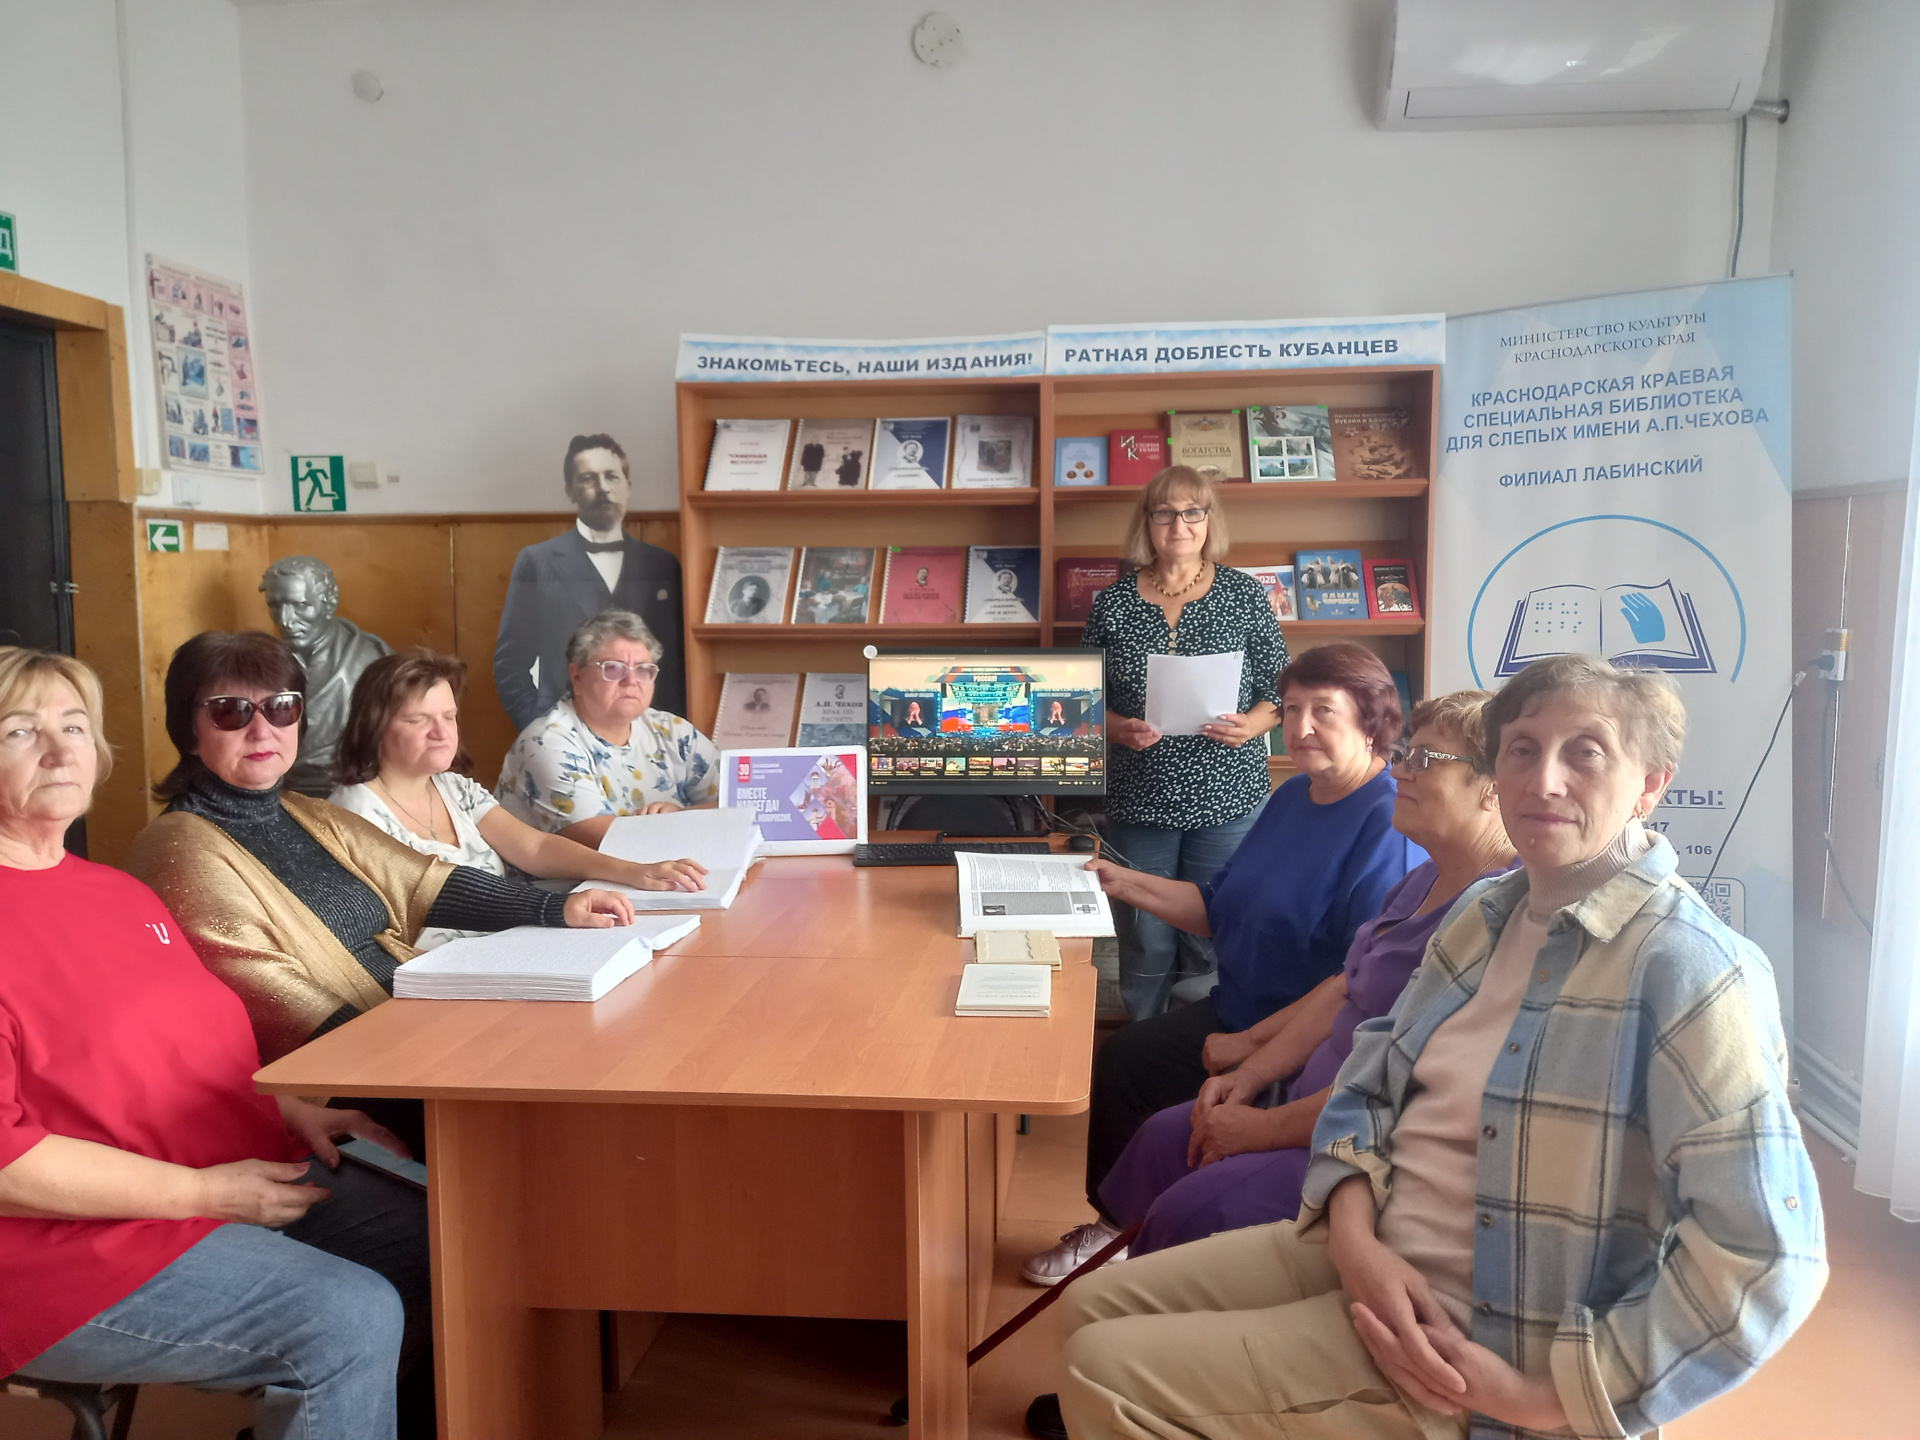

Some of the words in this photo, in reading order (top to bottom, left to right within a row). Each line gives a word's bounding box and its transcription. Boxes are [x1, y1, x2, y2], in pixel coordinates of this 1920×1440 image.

[1500, 322, 1624, 348] МИНИСТЕРСТВО
[1628, 312, 1706, 332] КУЛЬТУРЫ
[1065, 347, 1148, 363] РАТНАЯ
[1155, 344, 1272, 364] ДОБЛЕСТЬ
[1279, 339, 1399, 359] КУБАНЦЕВ
[1514, 337, 1653, 363] КРАСНОДАРСКОГО
[1657, 332, 1696, 347] КРАЯ
[697, 356, 850, 376] ЗНАКОМЬТЕСЬ,
[858, 359, 919, 374] НАШИ
[926, 353, 1033, 371] ИЗДАНИЯ!
[1471, 376, 1634, 407] КРАСНОДАРСКАЯ
[1641, 365, 1734, 389] КРАЕВАЯ
[1464, 402, 1603, 428] СПЕЦИАЛЬНАЯ
[1609, 387, 1743, 414] БИБЛИОТЕКА
[1182, 446, 1231, 454] БОГАТСТВА
[1446, 435, 1483, 453] ДЛЯ
[1488, 426, 1567, 448] СЛЕПЫХ
[1573, 420, 1640, 440] ИМЕНИ
[1499, 468, 1576, 488] ФИЛИАЛ
[1583, 455, 1703, 481] ЛАБИНСКИЙ
[738, 763, 750, 776] 30
[737, 787, 767, 800] ВМЕСТЕ
[1685, 844, 1713, 855] 106
